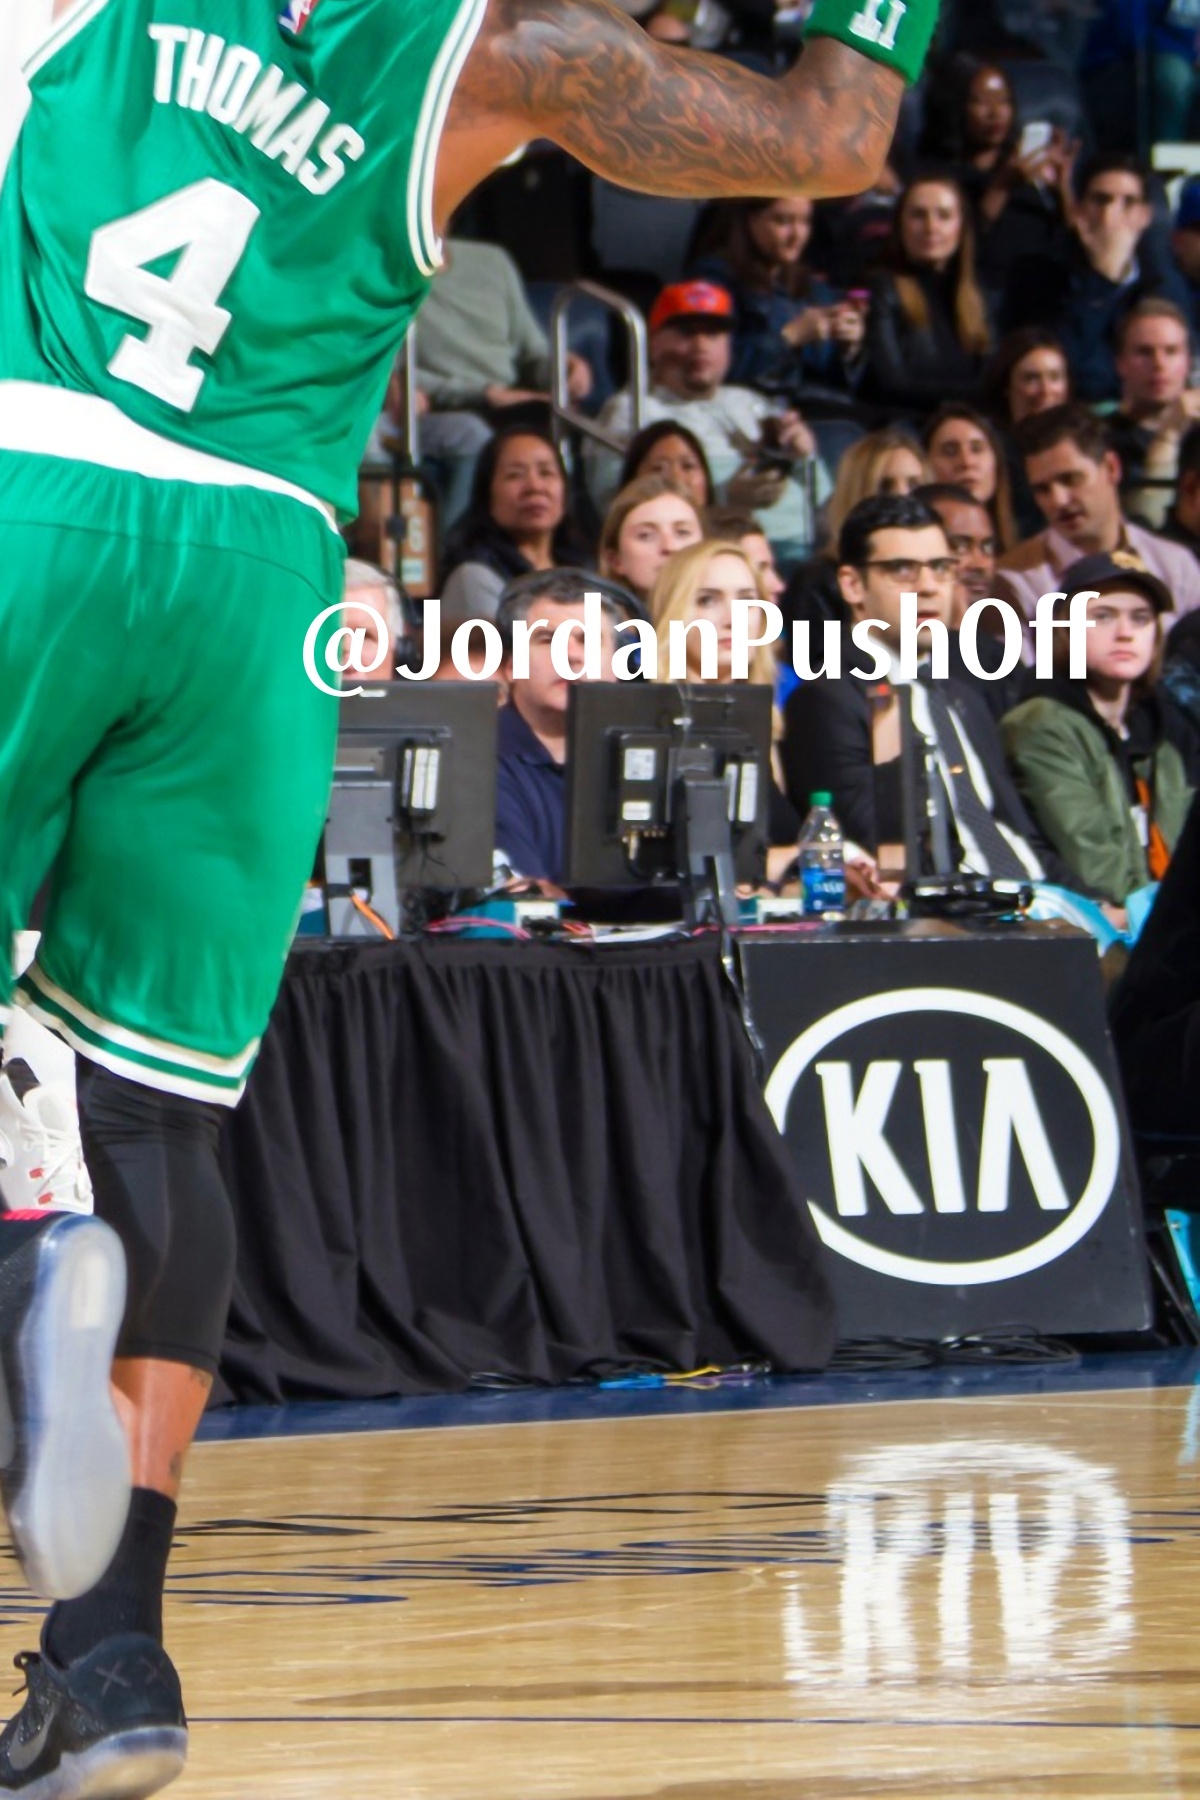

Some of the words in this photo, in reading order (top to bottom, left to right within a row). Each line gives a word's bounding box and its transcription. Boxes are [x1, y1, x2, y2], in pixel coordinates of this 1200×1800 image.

[148, 23, 365, 196] THOMAS
[84, 177, 261, 414] 4
[815, 1058, 1070, 1217] KIA
